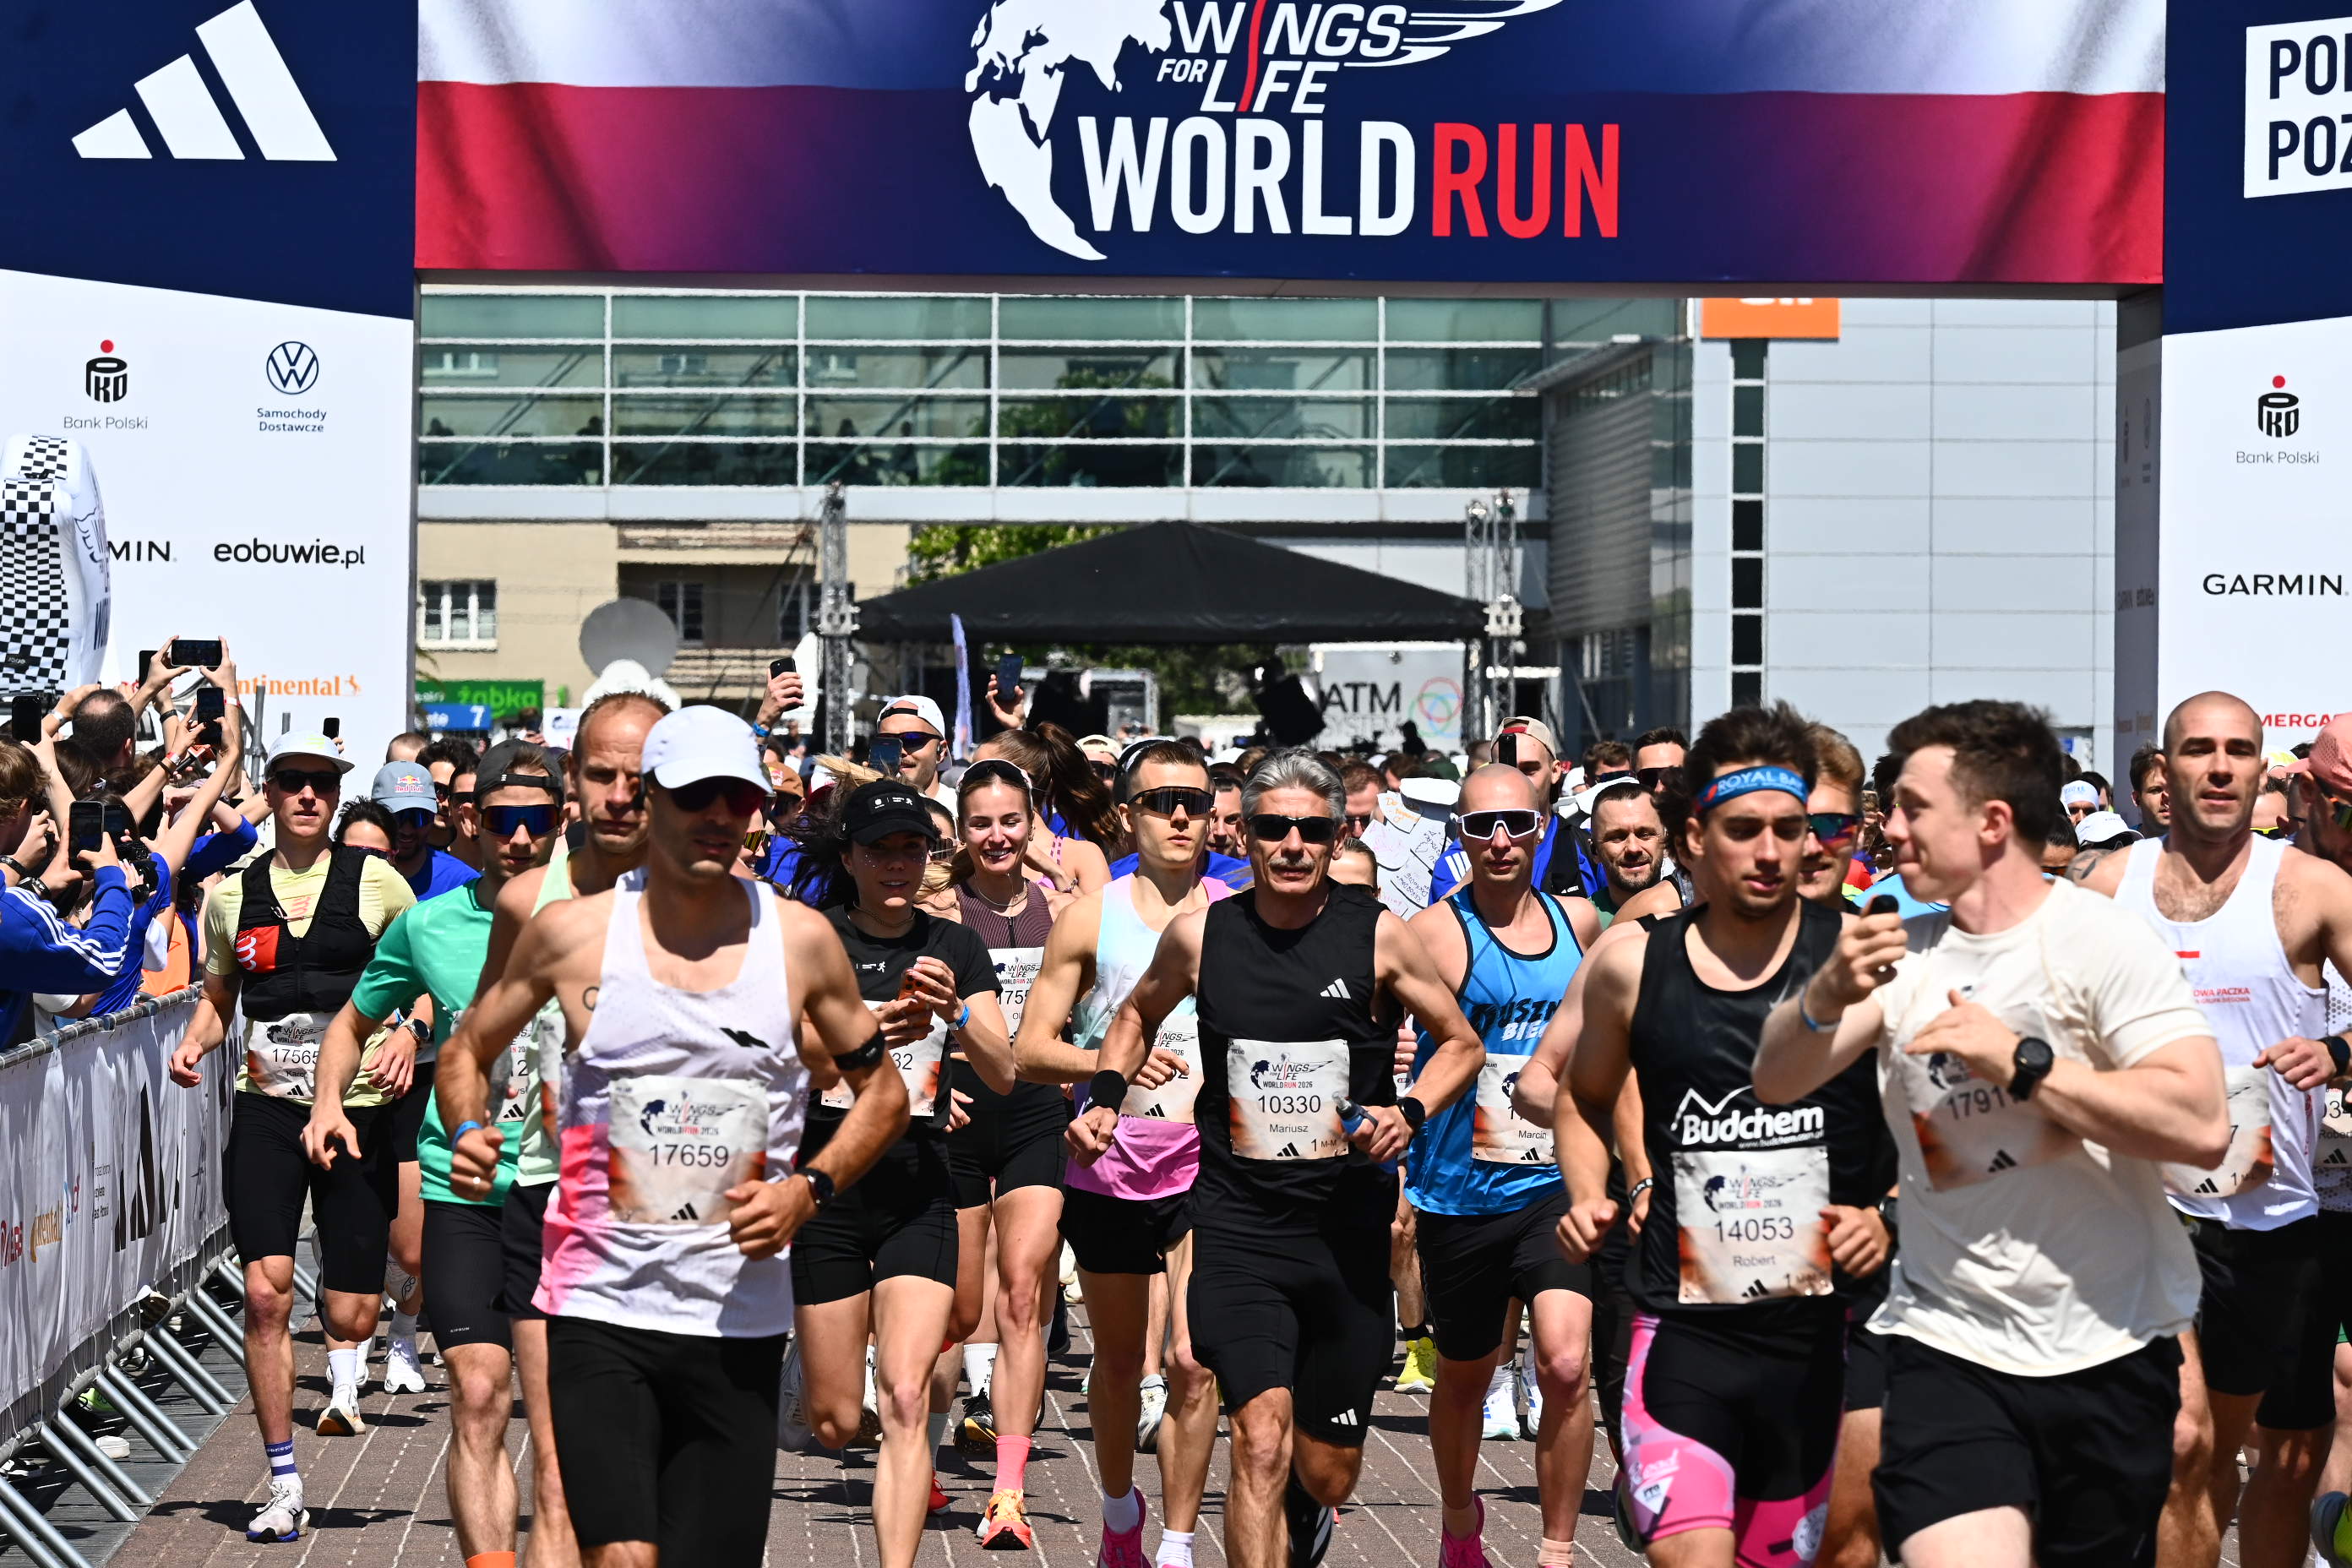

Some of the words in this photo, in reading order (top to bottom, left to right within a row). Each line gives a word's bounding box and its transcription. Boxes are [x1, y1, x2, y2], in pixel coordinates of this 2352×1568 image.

[1173, 0, 1407, 58] WINGS
[1157, 58, 1208, 84] FOR
[1200, 60, 1339, 114] LIFE
[1078, 117, 1416, 237] WORLD
[1431, 122, 1620, 239] RUN
[63, 416, 101, 430] Bank
[106, 416, 149, 430] Polski
[257, 408, 328, 421] Samochody
[259, 421, 324, 433] Dostawcze
[2236, 451, 2273, 464] Bank
[2278, 451, 2320, 464] Polski
[106, 541, 171, 562] MIN
[214, 537, 366, 569] eobuwie.pl
[2202, 574, 2343, 596] GARMIN
[237, 675, 341, 696] ntinental
[1326, 682, 1402, 713] ATM
[470, 705, 485, 727] 7
[2262, 713, 2337, 728] MERGA
[1718, 770, 1776, 792] ROYAL
[999, 989, 1029, 1004] 175
[272, 1048, 319, 1064] 17565
[1271, 1063, 1309, 1071] WINGS
[1258, 1095, 1321, 1113] 10330
[1946, 1085, 2006, 1121] 1791
[1269, 1124, 1309, 1133] Mariusz
[1518, 1130, 1547, 1139] Marcin
[1681, 1107, 1825, 1146] Budchem
[1310, 1138, 1317, 1152] 1
[649, 1144, 729, 1168] 17659
[1714, 1217, 1794, 1243] 14053
[1733, 1255, 1777, 1266] Robert
